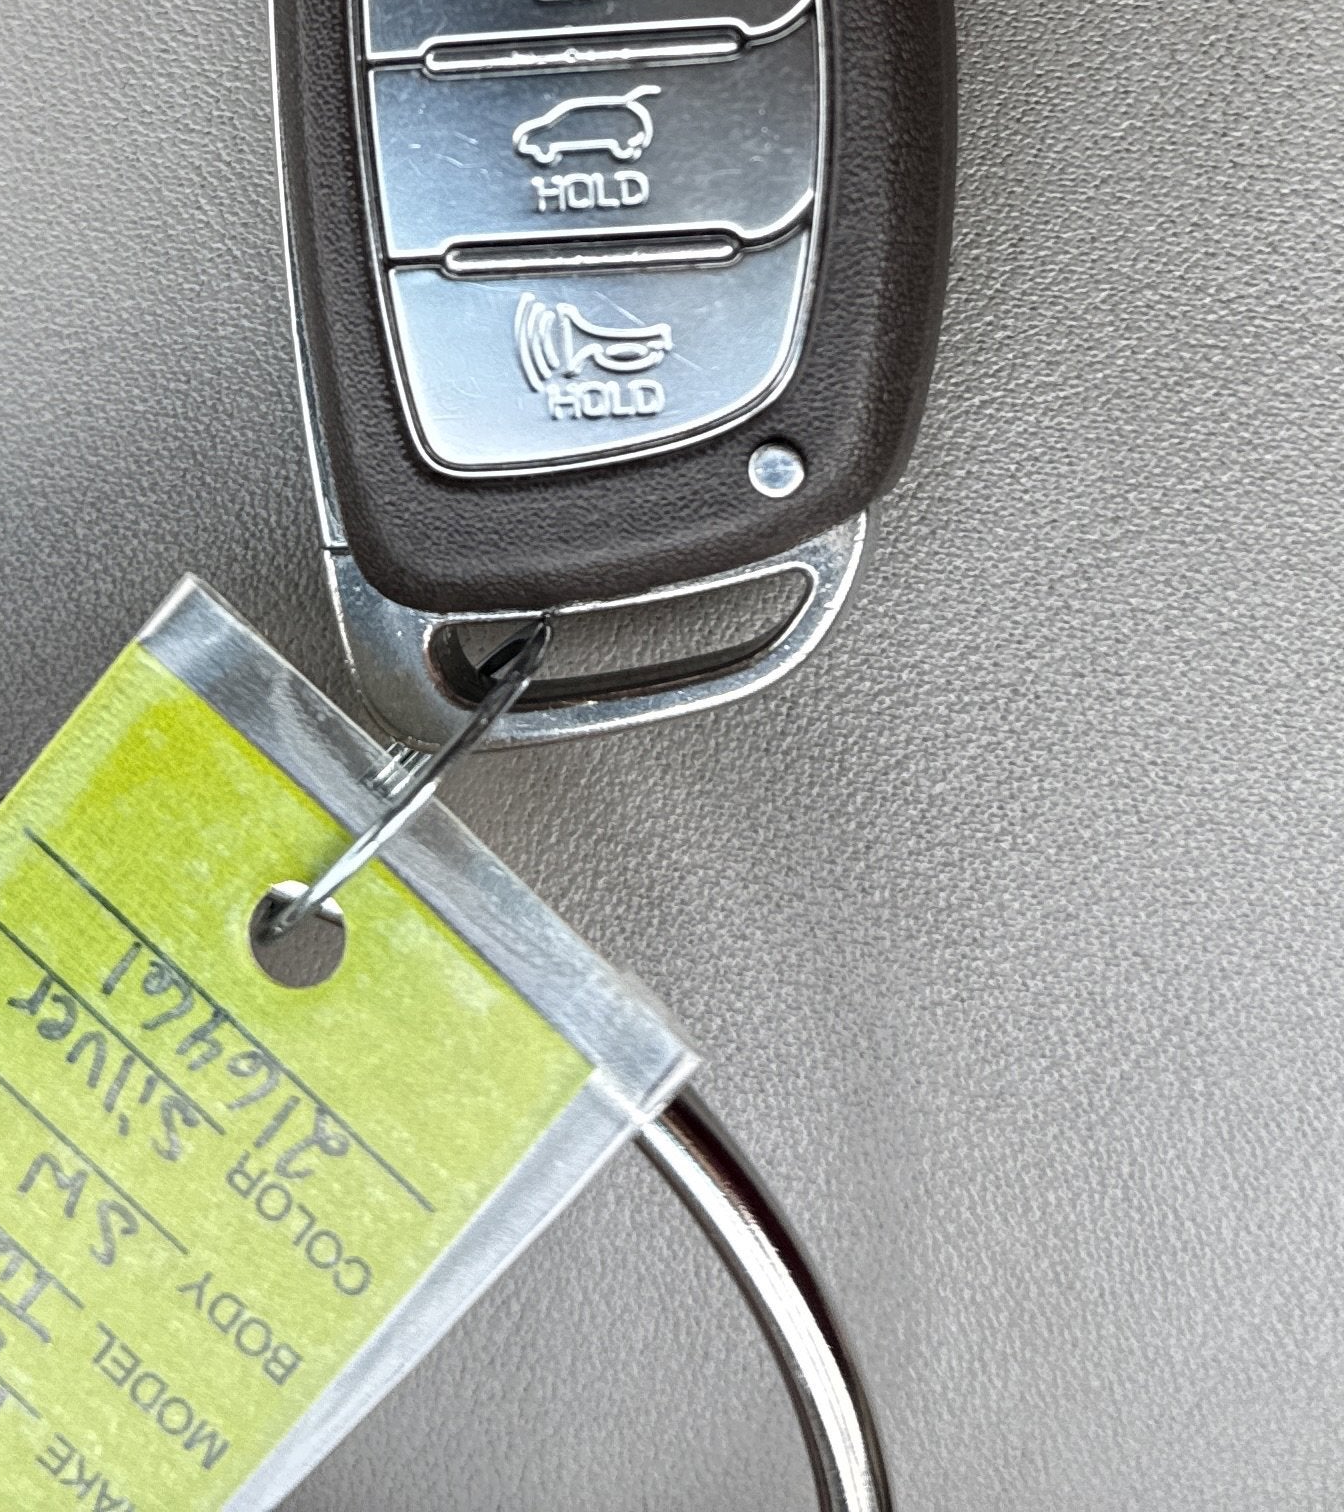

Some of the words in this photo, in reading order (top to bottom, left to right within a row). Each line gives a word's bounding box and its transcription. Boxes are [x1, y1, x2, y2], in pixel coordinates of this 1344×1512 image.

[530, 169, 651, 213] HOLD
[546, 378, 666, 420] HOLD
[225, 1150, 373, 1297] COLOR
[176, 1271, 305, 1387] BODY
[91, 1320, 231, 1472] MODEL
[35, 1432, 139, 1512] AKE
